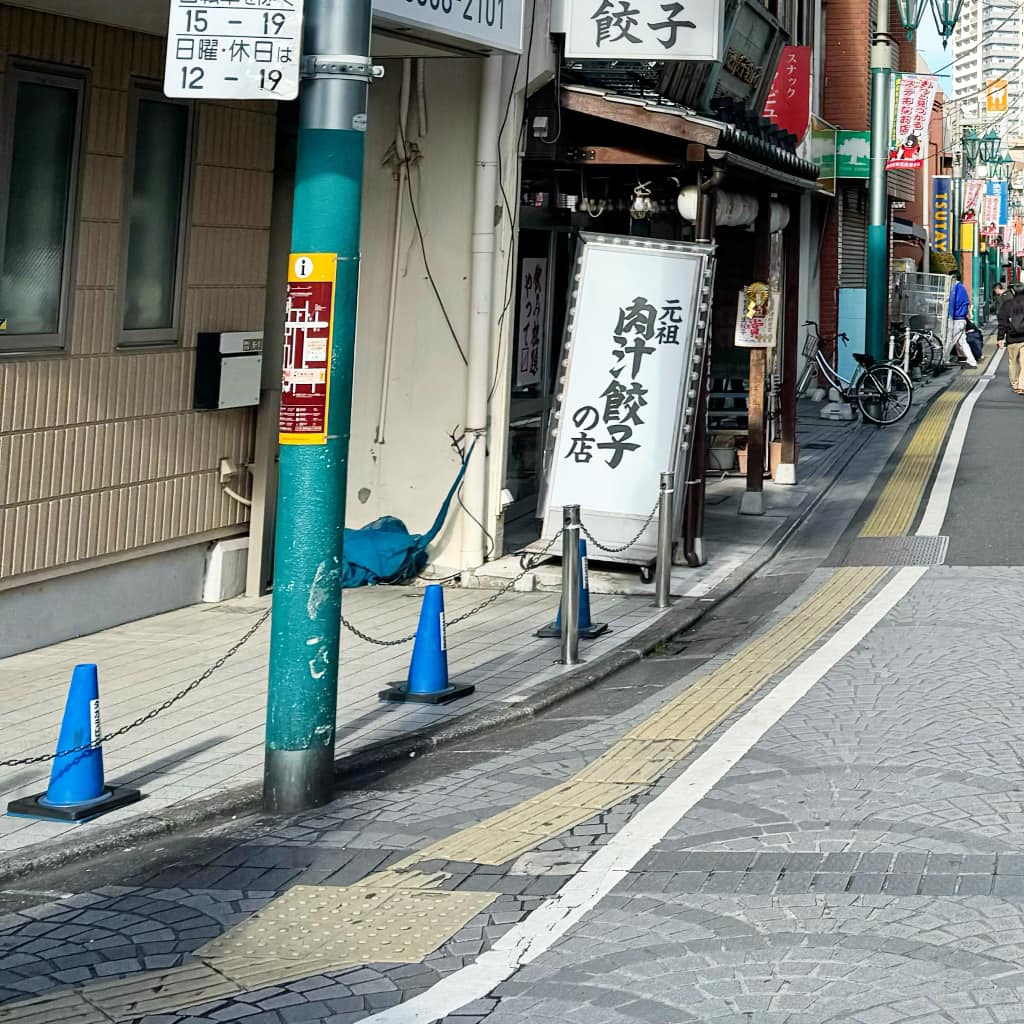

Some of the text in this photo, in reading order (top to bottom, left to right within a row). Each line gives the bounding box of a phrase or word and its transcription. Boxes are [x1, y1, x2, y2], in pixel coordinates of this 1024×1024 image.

[186, 10, 208, 33] 15
[263, 12, 286, 35] 19
[176, 38, 293, 63] 日曜・休日は
[181, 66, 205, 89] 12
[259, 69, 283, 91] 19
[784, 54, 797, 98] スナック
[655, 299, 683, 345] 元祖
[597, 296, 658, 469] 肉汁餃子
[564, 405, 600, 464] の店
